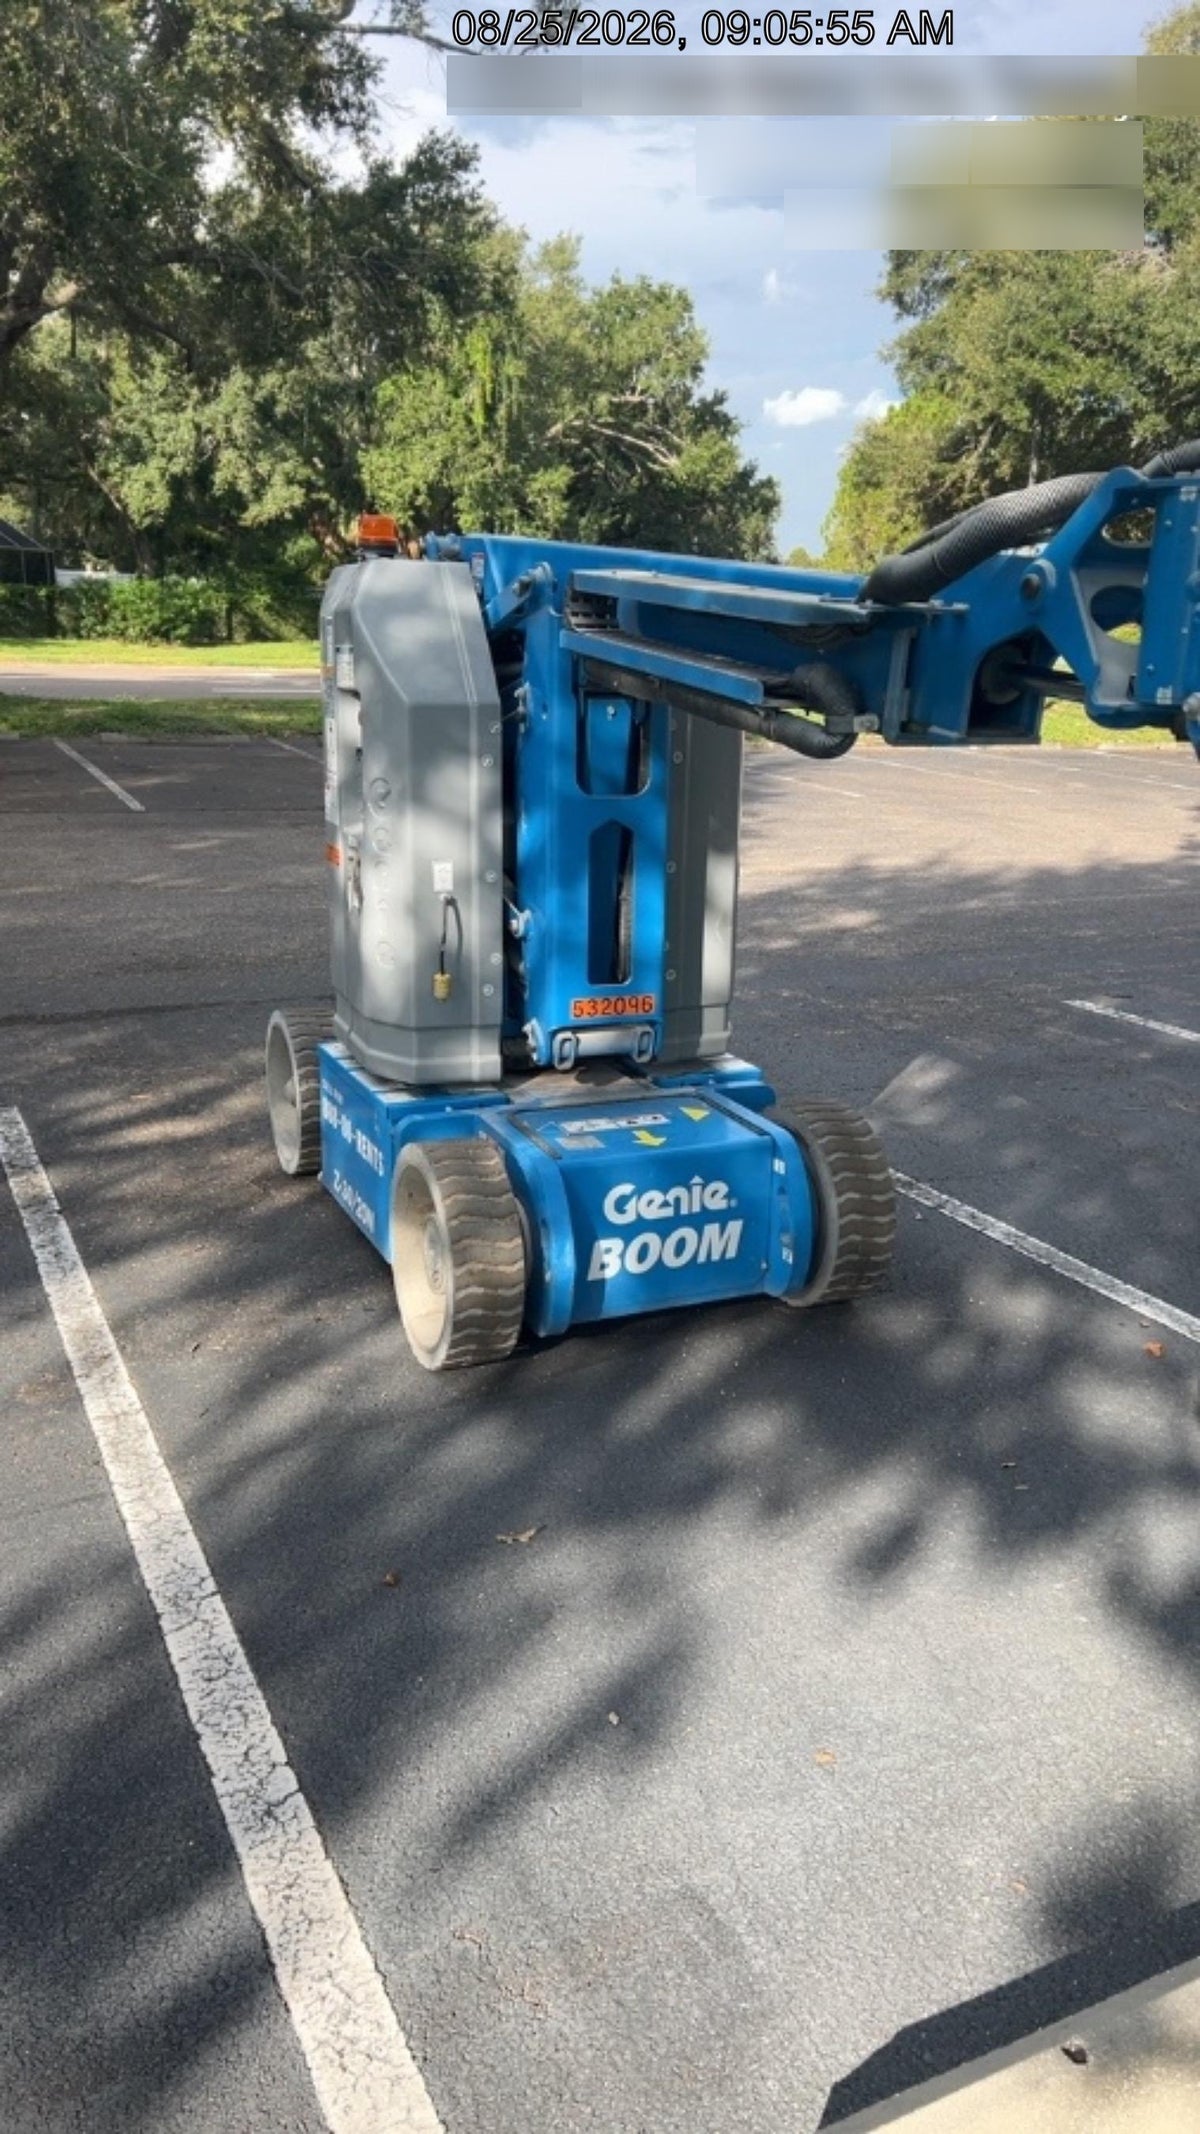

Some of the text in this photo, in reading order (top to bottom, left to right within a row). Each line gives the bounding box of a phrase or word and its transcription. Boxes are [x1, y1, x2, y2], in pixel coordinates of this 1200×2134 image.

[573, 995, 654, 1018] 532096
[603, 1174, 730, 1225] Genie
[587, 1219, 744, 1282] BOOM
